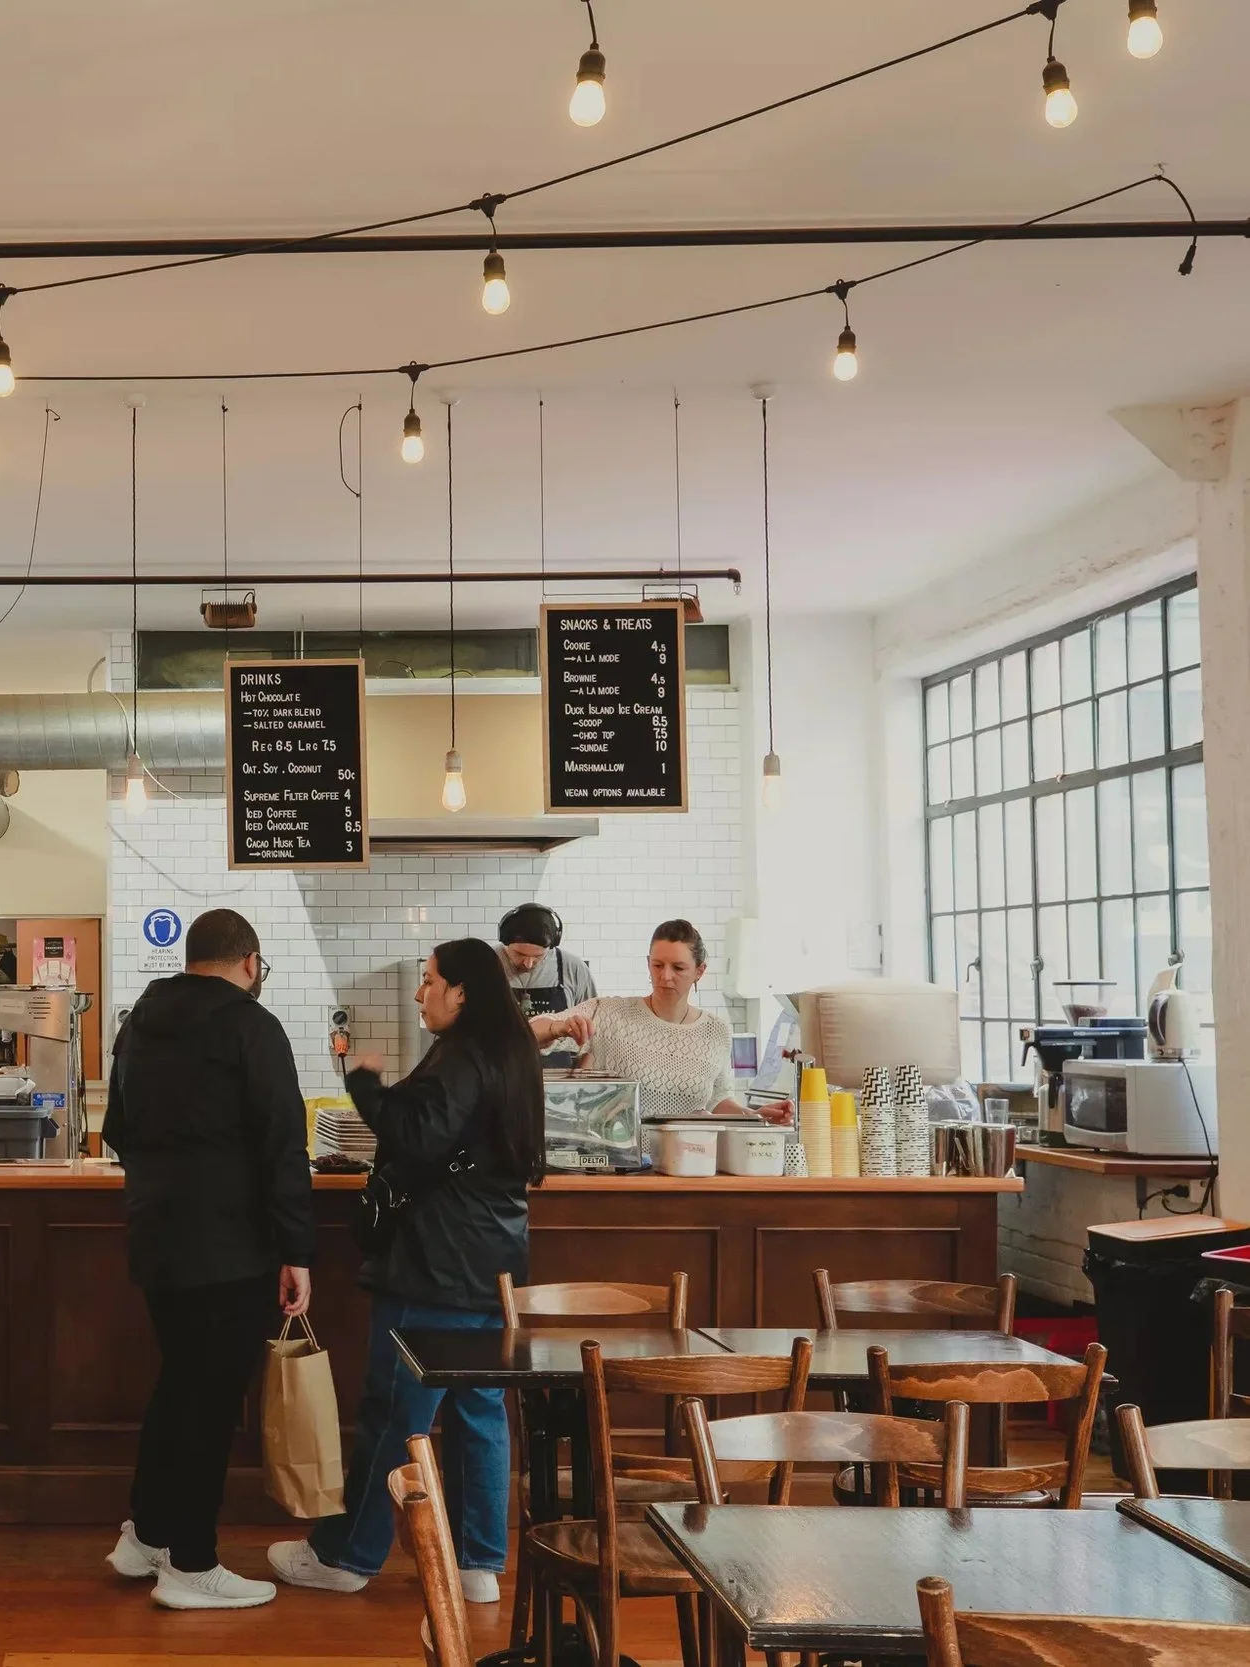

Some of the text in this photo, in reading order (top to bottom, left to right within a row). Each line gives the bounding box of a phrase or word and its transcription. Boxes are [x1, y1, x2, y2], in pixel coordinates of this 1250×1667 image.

[561, 619, 652, 631] SNACKS & TREATS
[564, 640, 591, 650] COOKIE
[651, 641, 666, 652] 4.5
[577, 655, 582, 663] A
[585, 655, 595, 663] LA
[659, 654, 666, 664] 9
[241, 674, 282, 685] DRINKS
[564, 672, 597, 683] BROWNIE
[651, 673, 665, 684] 4.5
[241, 691, 256, 702] HOT
[579, 687, 620, 695] A LA MODE
[658, 688, 665, 698] 9
[273, 709, 293, 717] DARK
[294, 709, 321, 717] BLEND
[565, 703, 663, 715] DUCK ISLAND ICE CREAM
[287, 721, 326, 729] CARAMEL
[652, 716, 668, 727] 6.5
[602, 731, 615, 739] TOP
[653, 728, 667, 739] 7.5
[275, 740, 292, 752] 6.5
[322, 740, 336, 751] 7.5
[580, 744, 608, 752] SUNDAE
[655, 741, 667, 751] 10
[288, 762, 322, 774] COCONUT
[565, 761, 624, 772] MARSHMALLOW
[662, 763, 665, 774] 1
[244, 790, 339, 801] SUPREME FILTER COFFEE
[344, 789, 351, 800] 4
[565, 788, 665, 797] VEGAN OPTIONS AVAILABLE
[246, 808, 297, 818] ICED COFFEE
[345, 807, 351, 817] 5
[246, 820, 309, 831] ICED CHOCOLATE
[345, 821, 361, 833] 6.5
[246, 837, 311, 848] CACAO HUSK TEA
[346, 841, 353, 852] 3
[262, 850, 294, 858] ORIGINAL
